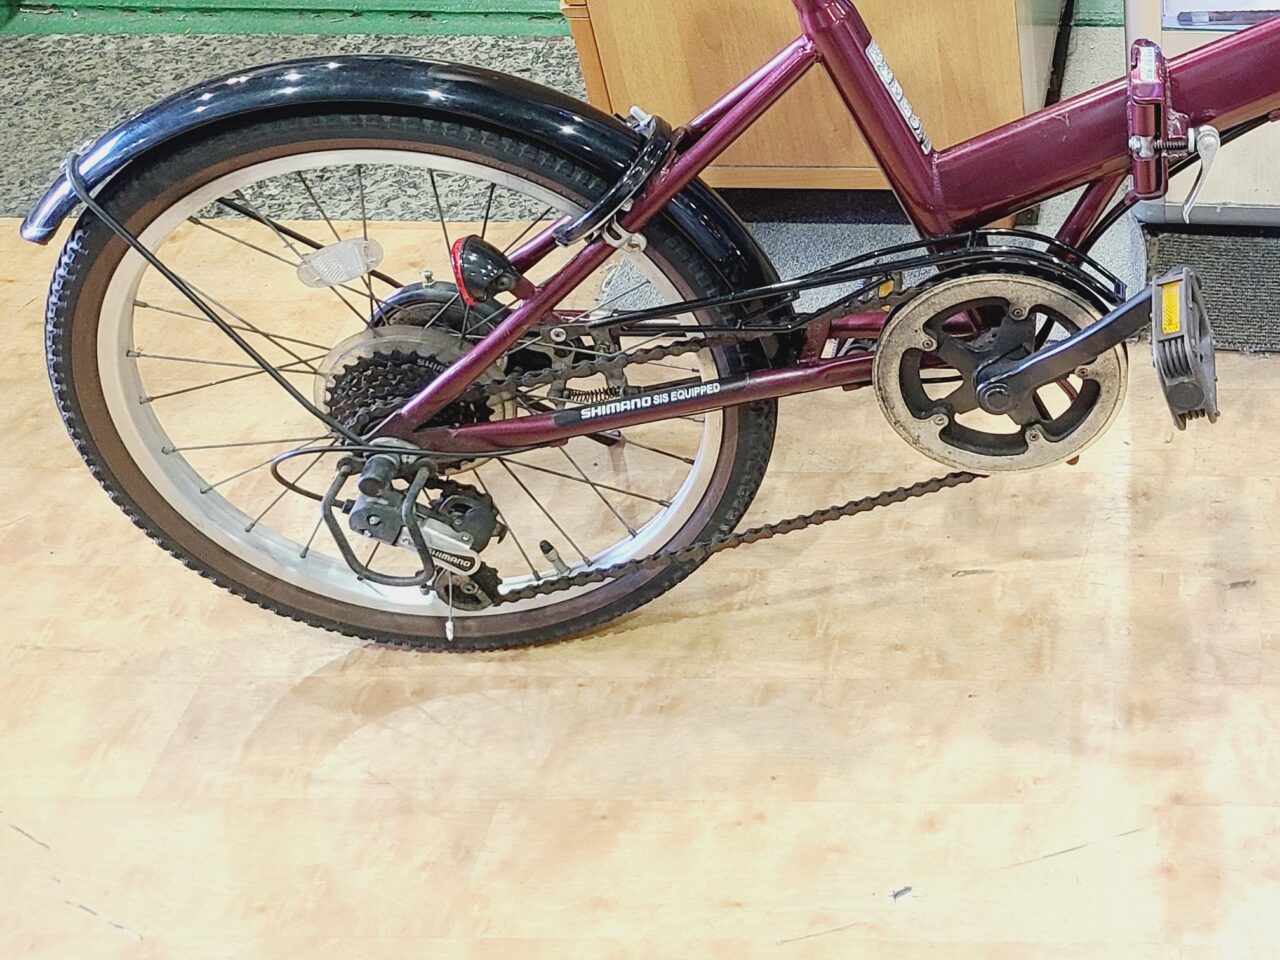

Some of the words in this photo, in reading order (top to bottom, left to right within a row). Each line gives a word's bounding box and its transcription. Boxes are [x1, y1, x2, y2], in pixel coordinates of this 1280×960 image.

[580, 395, 652, 419] SHIMANO
[653, 392, 670, 405] SIS
[671, 382, 721, 401] EQUIPPED
